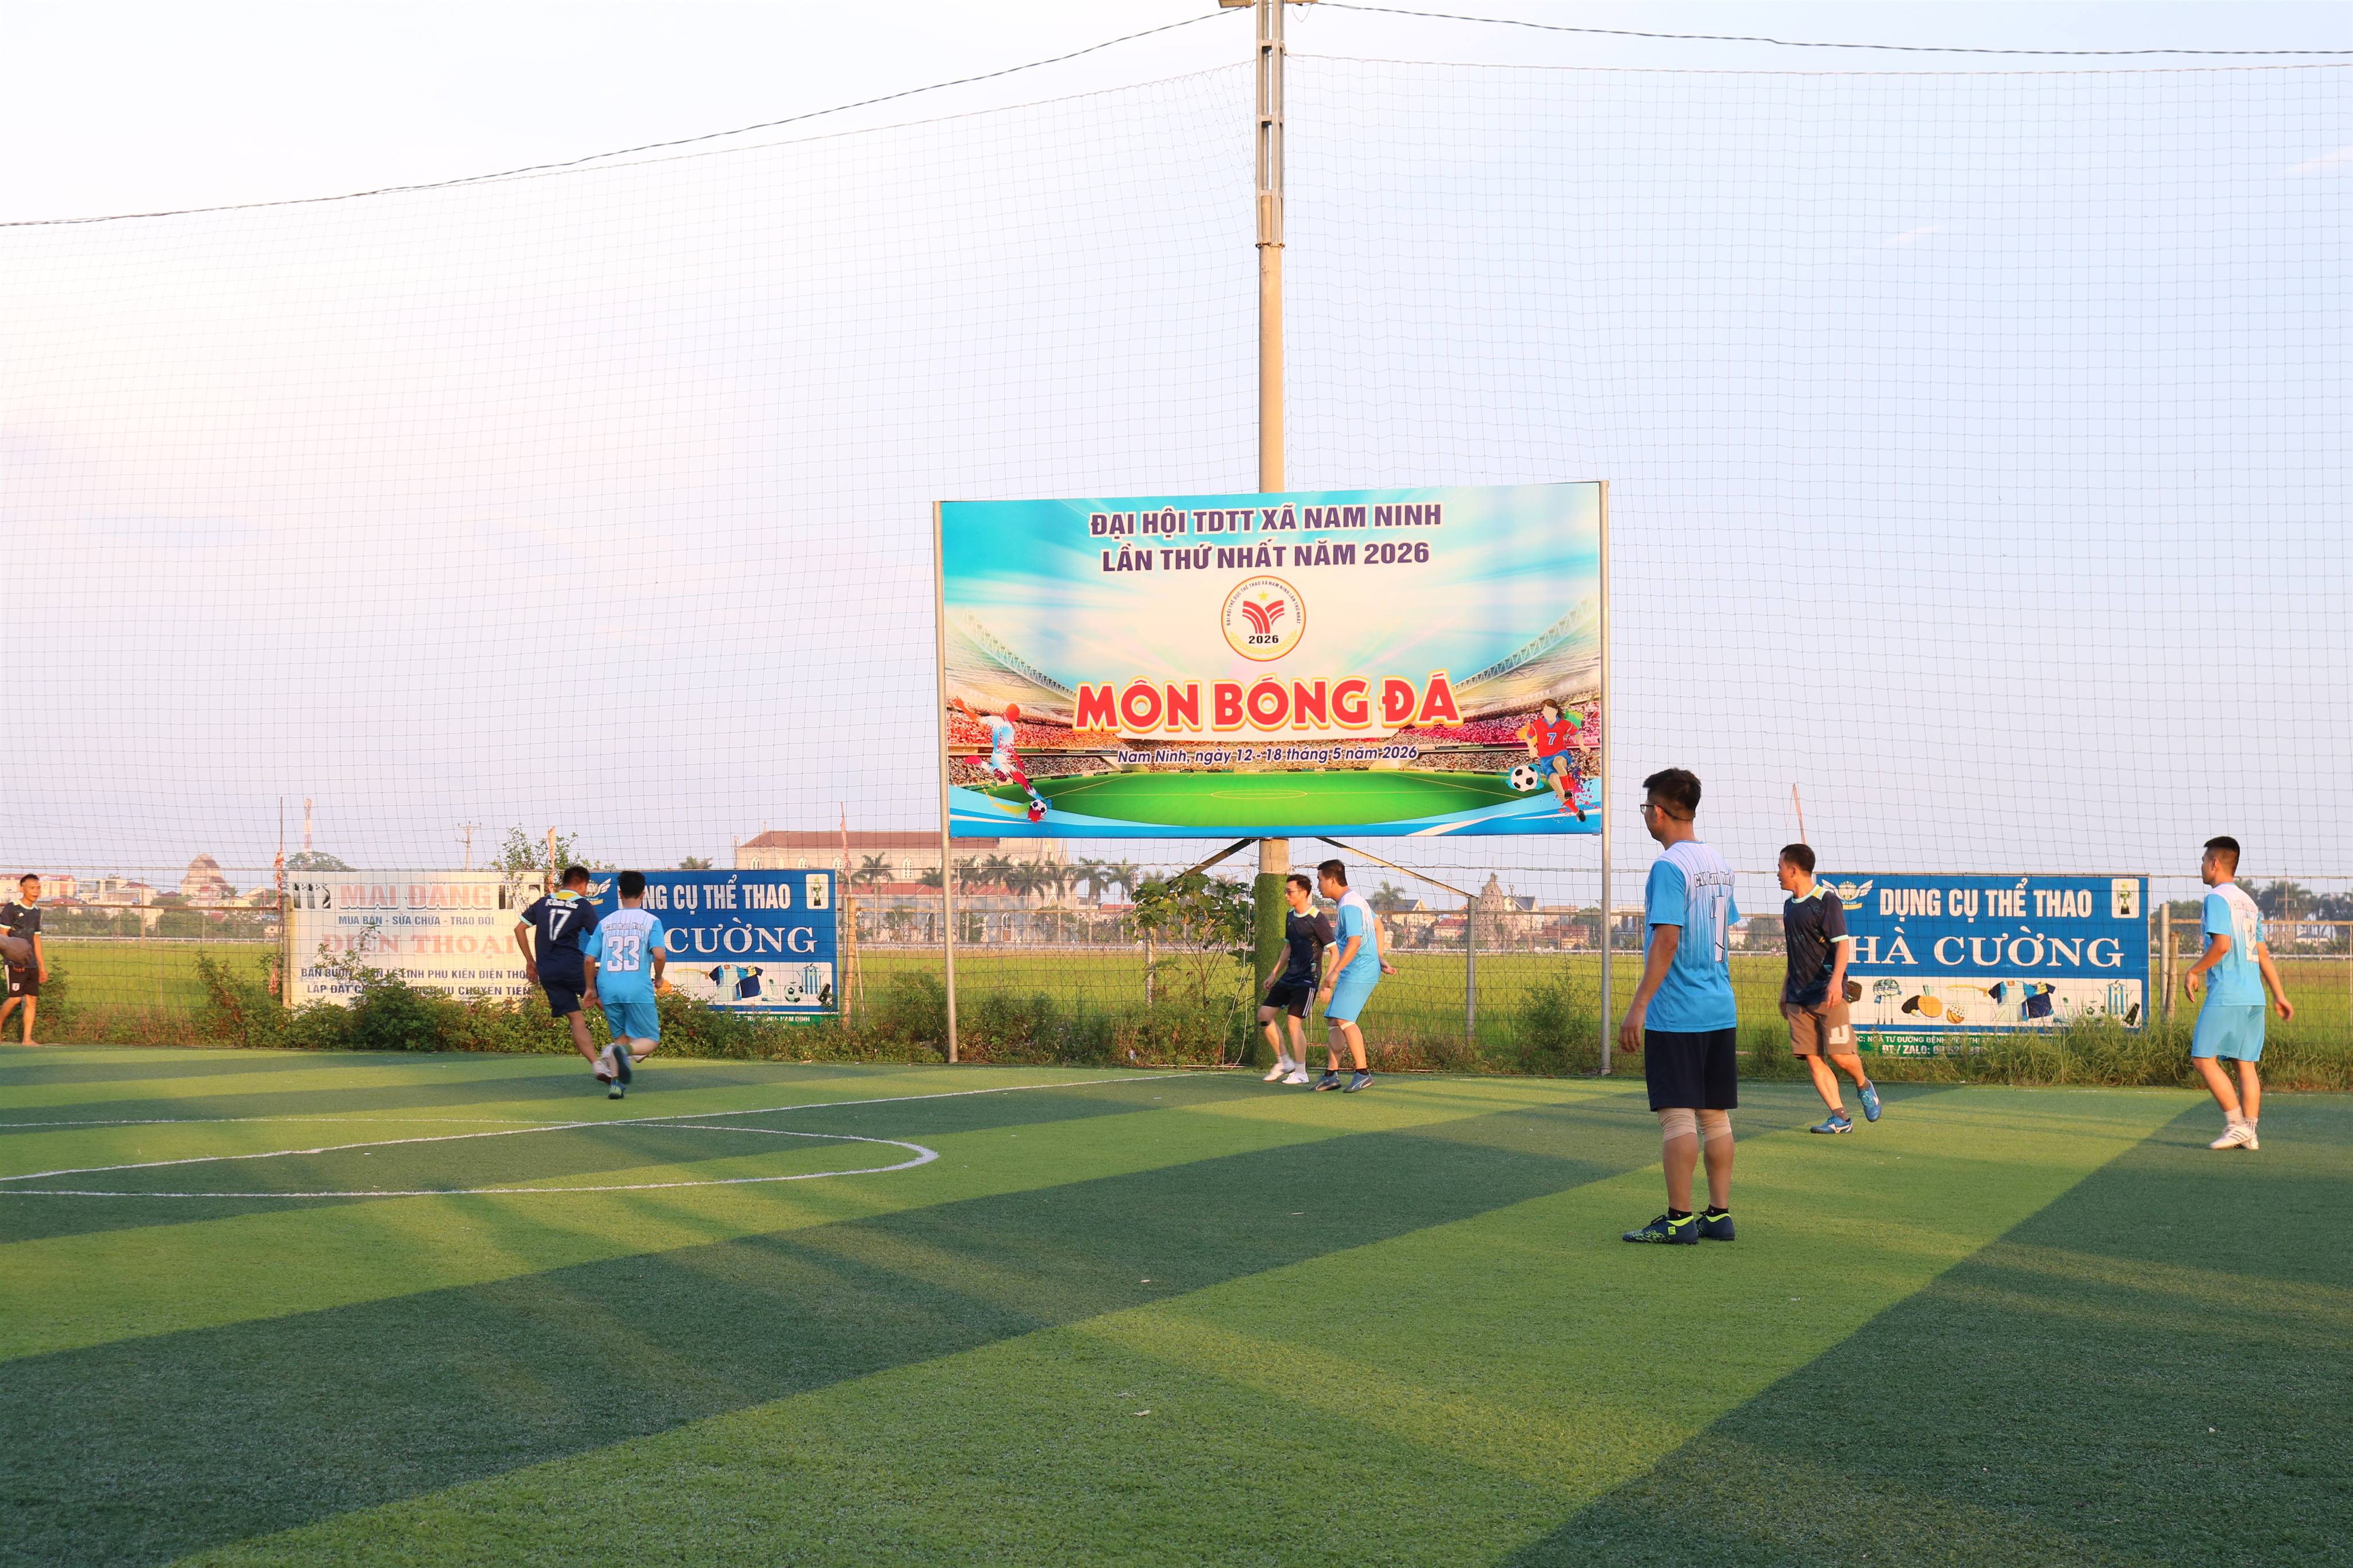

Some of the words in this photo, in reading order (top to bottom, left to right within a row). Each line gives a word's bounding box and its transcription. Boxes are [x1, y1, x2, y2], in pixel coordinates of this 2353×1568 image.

[1091, 514, 1134, 539] ĐẠI
[1143, 508, 1186, 538] HỘI
[1193, 510, 1255, 532] TDTT
[1262, 504, 1297, 530] XÃ
[1305, 506, 1365, 529] NAM
[1375, 504, 1441, 527] NINH
[1103, 543, 1152, 571] LẦN
[1160, 544, 1212, 570] THỨ
[1217, 539, 1287, 569] NHẤT
[1294, 540, 1356, 566] NĂM
[1364, 542, 1430, 564] 2026
[1248, 635, 1279, 644] 2026
[1074, 678, 1199, 729] MÔN
[1212, 675, 1370, 728] BÓNG
[1379, 672, 1461, 724] ĐÁ
[1547, 732, 1557, 745] 7
[1118, 750, 1150, 763] Nam
[1155, 750, 1190, 764] Ninh,
[1195, 748, 1232, 765] ngày
[1237, 749, 1253, 762] 12
[1266, 748, 1282, 761] 18
[1287, 746, 1328, 763] tháng
[1332, 747, 1341, 759] 5
[1345, 747, 1377, 759] năm
[1382, 746, 1418, 759] 2026
[338, 883, 399, 910] MAI
[673, 884, 698, 915] CỤ
[703, 874, 738, 910] THỂ
[742, 883, 791, 910] THAO
[1879, 888, 1942, 922] DỤNG
[1948, 889, 1979, 923] CỤ
[1985, 877, 2027, 918] THỂ
[2032, 888, 2092, 918] THAO
[338, 916, 360, 925] MUA
[362, 913, 383, 925] BÁN
[450, 916, 475, 925] TRAO
[548, 908, 572, 941] 17
[664, 917, 817, 953] CƯỜNG
[410, 934, 516, 959] THOẠI
[607, 935, 640, 972] 33
[1847, 926, 1919, 965] HÀ
[1932, 926, 2125, 968] CƯỜNG
[427, 970, 448, 980] PHỤ
[452, 968, 475, 981] KIỆN
[479, 968, 503, 981] ĐIỆN
[1897, 1034, 1924, 1043] ĐƯỜNG
